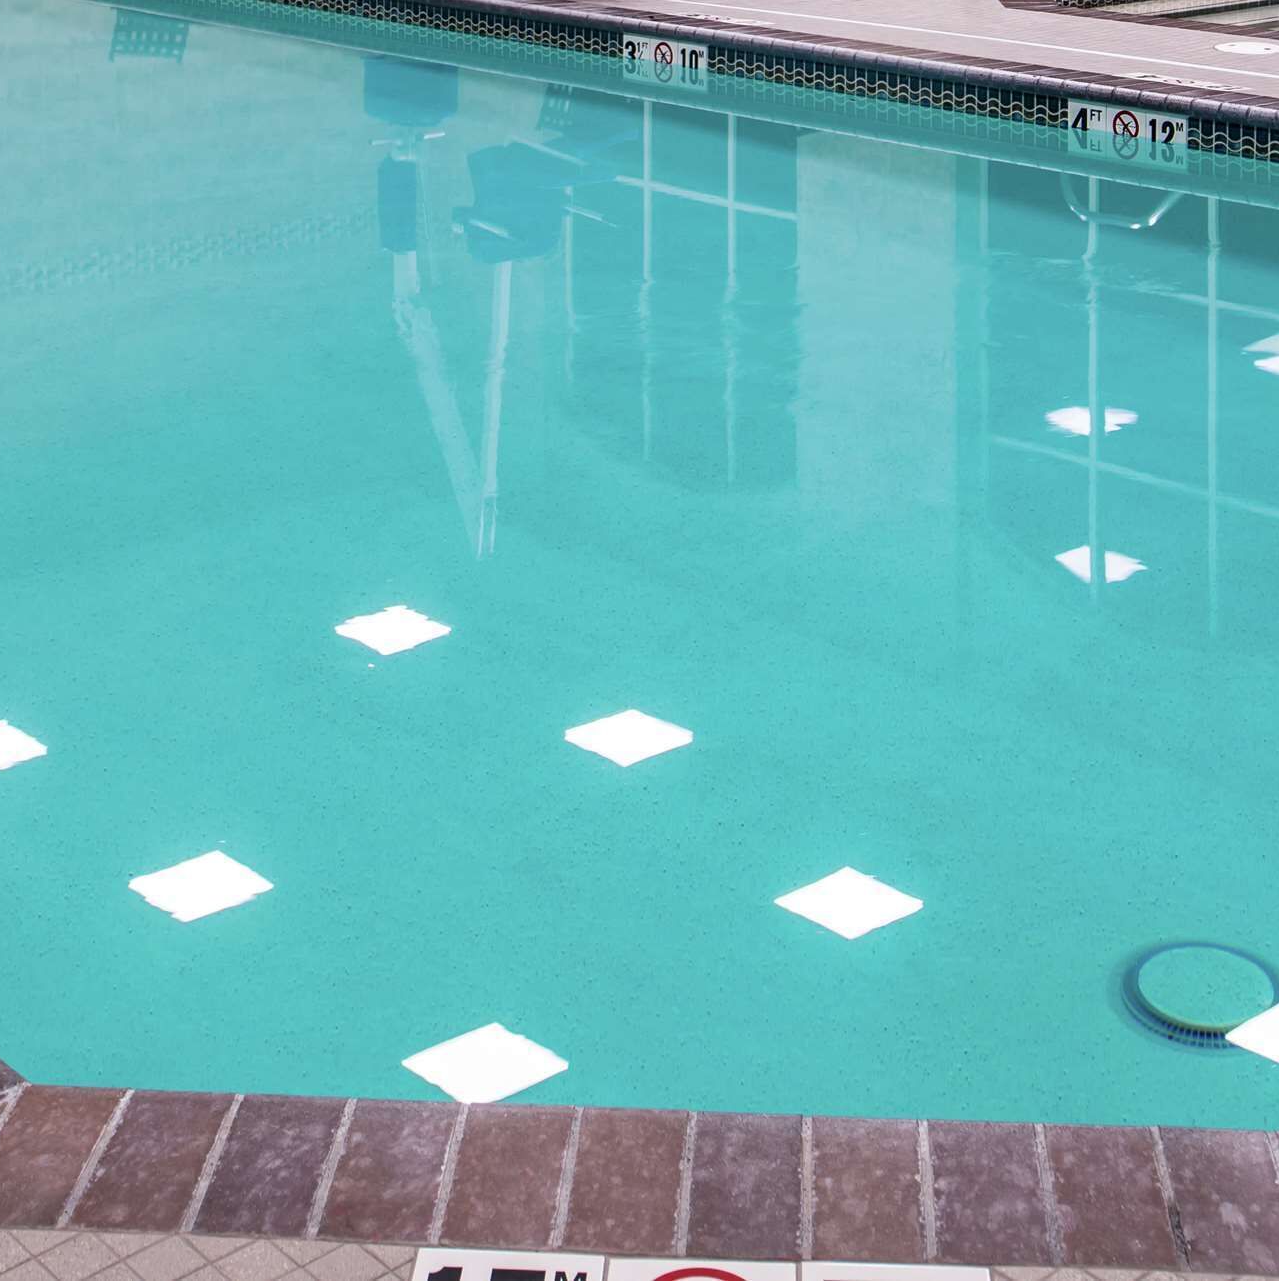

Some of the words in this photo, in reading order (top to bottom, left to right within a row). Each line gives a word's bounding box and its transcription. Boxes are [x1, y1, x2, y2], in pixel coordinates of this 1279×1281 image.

[1072, 107, 1089, 131] 4
[1090, 109, 1102, 122] FT
[1176, 122, 1183, 132] M
